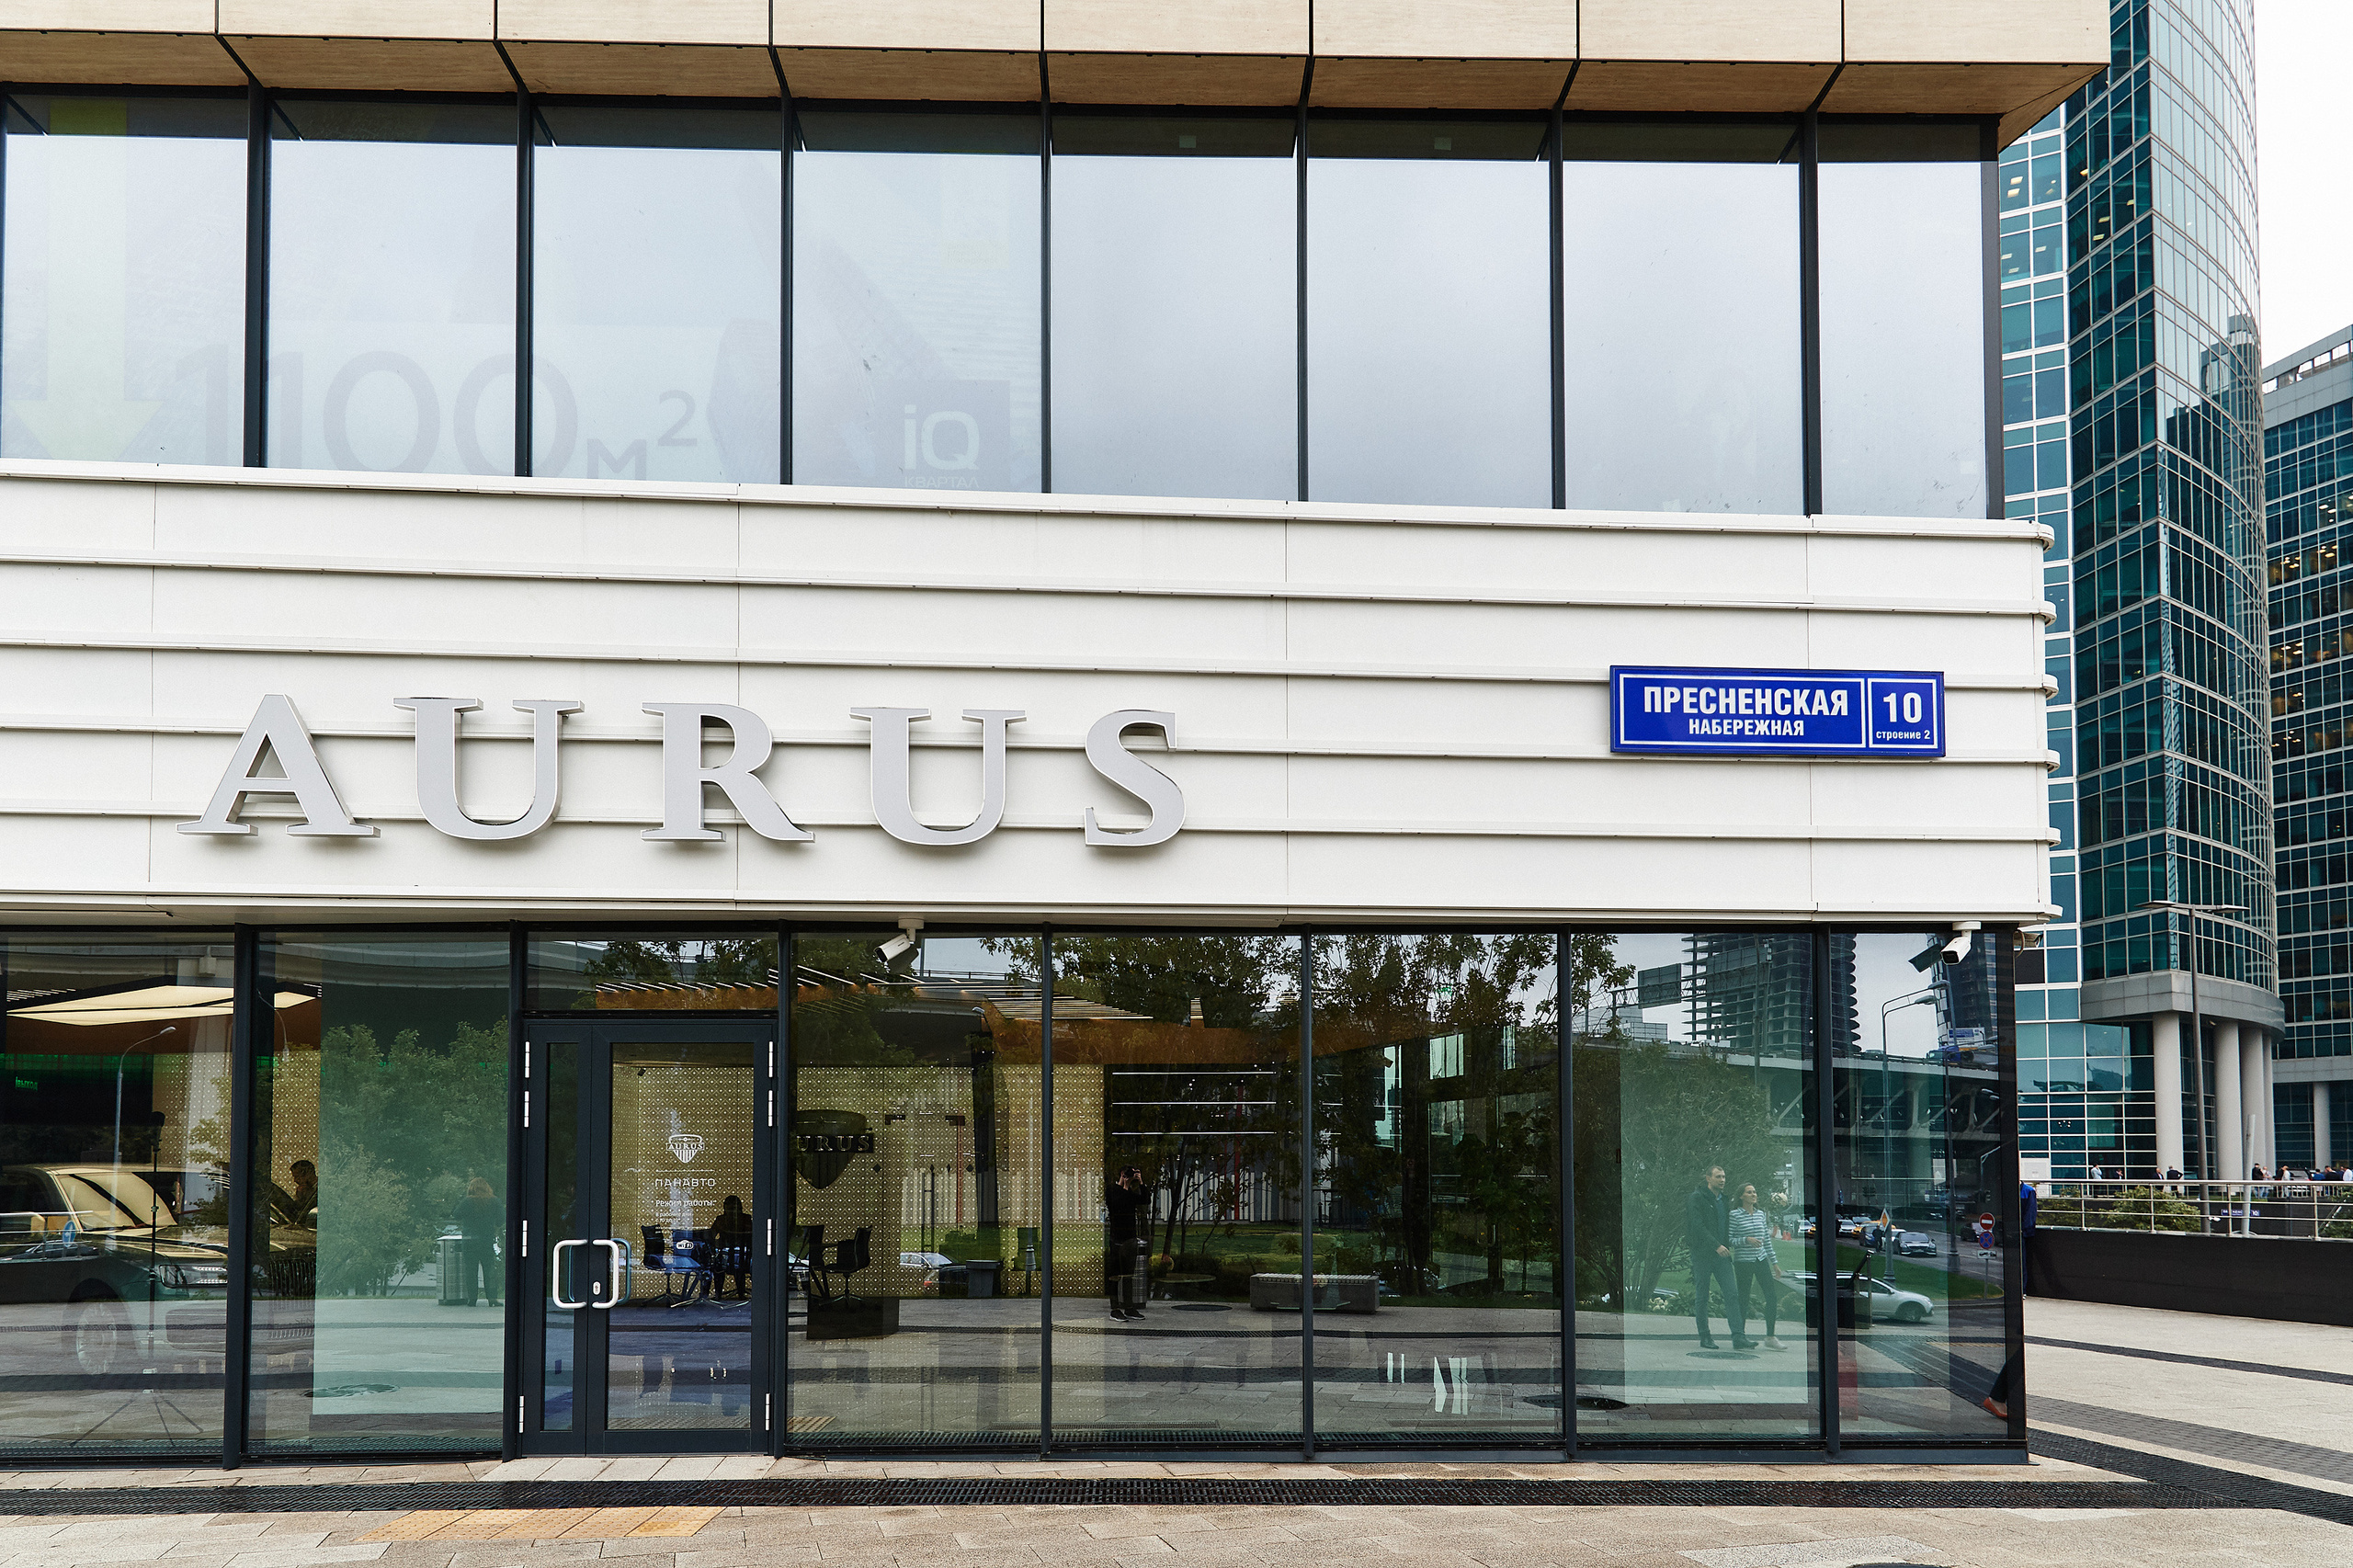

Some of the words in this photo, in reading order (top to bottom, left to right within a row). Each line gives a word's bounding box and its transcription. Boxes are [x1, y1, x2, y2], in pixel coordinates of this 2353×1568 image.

[904, 404, 980, 471] iQ
[904, 476, 979, 488] КВАРТАЛ
[1643, 686, 1848, 716] ПРЕСНЕНСКАЯ
[1883, 692, 1923, 723] 10
[1688, 718, 1804, 736] НАБЕРЕЖНАЯ
[1876, 731, 1922, 741] строение
[1924, 729, 1931, 739] 2
[176, 693, 1186, 847] AURUS
[796, 1135, 870, 1152] URUS
[654, 1177, 715, 1187] ПАНАВТО
